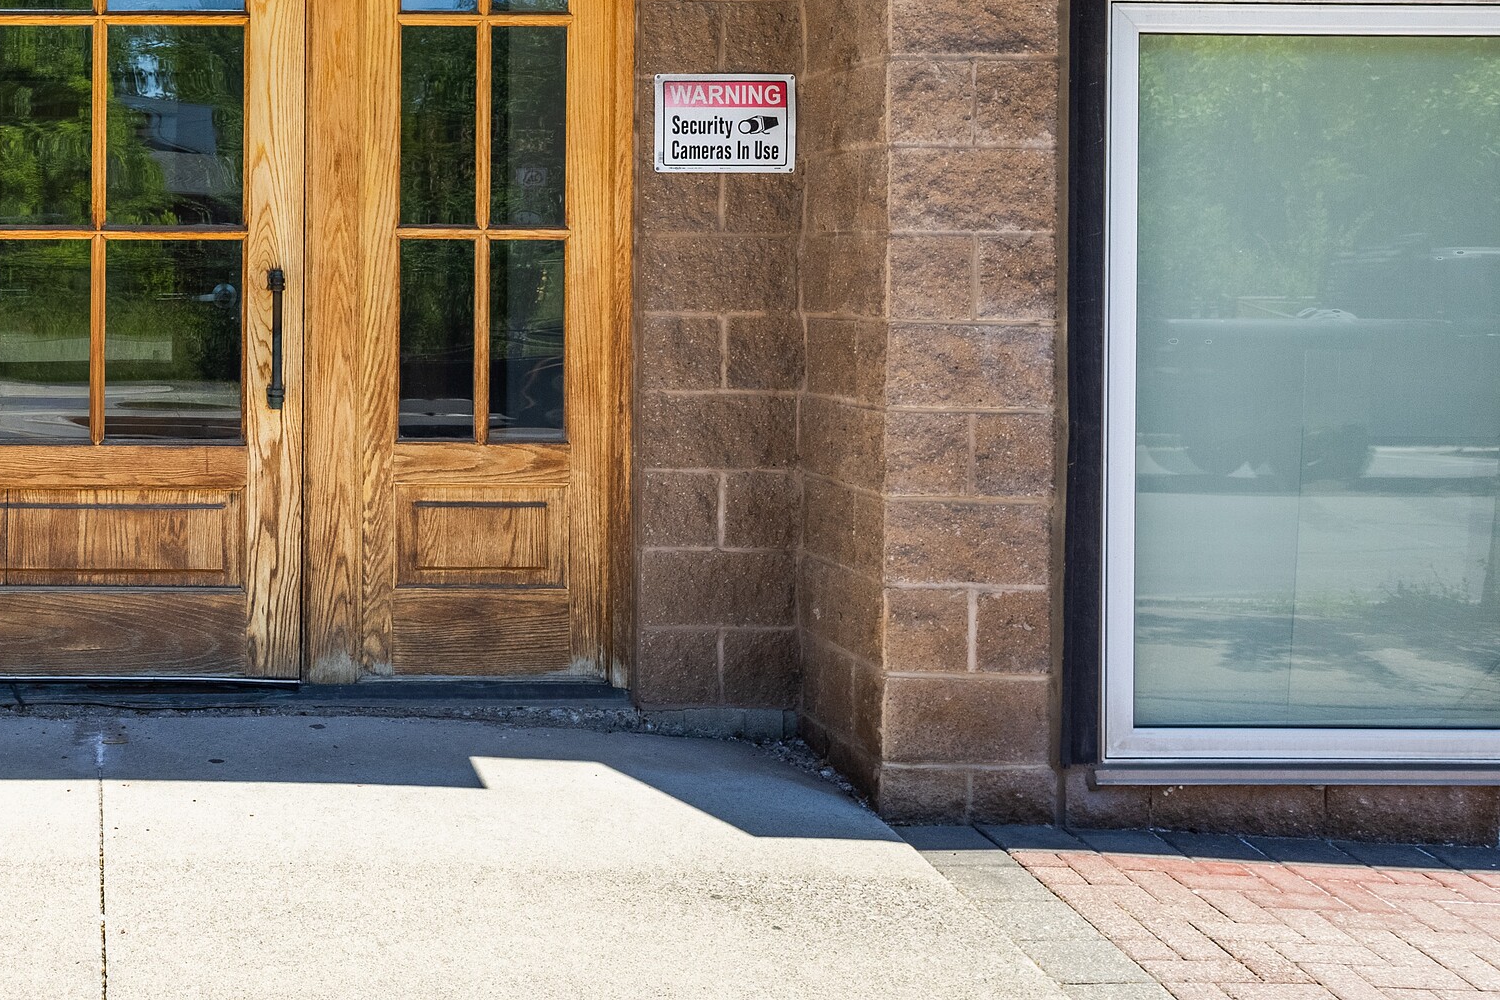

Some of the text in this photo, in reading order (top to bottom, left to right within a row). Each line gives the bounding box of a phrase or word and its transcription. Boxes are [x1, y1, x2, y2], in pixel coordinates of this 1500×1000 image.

[669, 85, 781, 105] WARNING
[671, 115, 733, 138] Security
[672, 140, 732, 160] Cameras
[737, 140, 749, 160] In
[754, 140, 779, 160] Use
